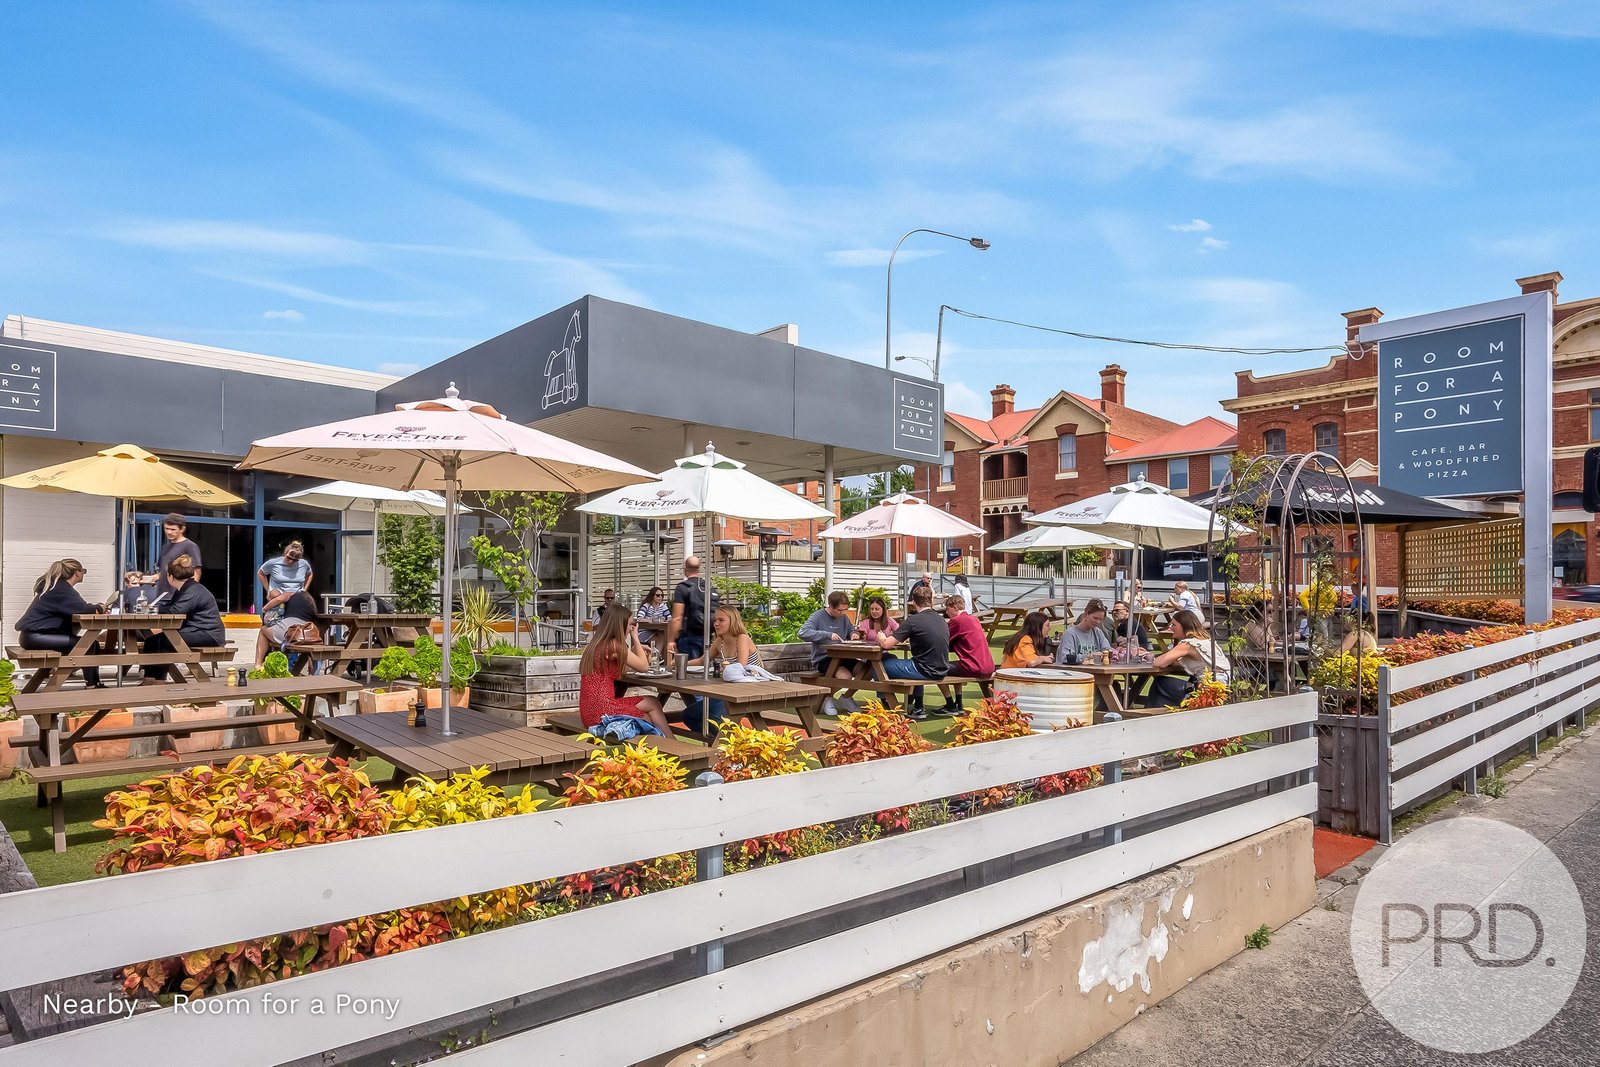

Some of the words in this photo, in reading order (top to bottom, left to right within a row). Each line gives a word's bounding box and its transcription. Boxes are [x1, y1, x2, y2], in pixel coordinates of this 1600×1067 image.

[1394, 341, 1504, 369] ROOM
[11, 363, 41, 374] OM
[1394, 377, 1455, 396] FOR
[1491, 370, 1504, 383] A
[11, 396, 40, 406] NY
[901, 395, 933, 408] ROOM
[901, 409, 919, 419] FOR
[1394, 399, 1504, 423] PONY
[901, 424, 933, 436] PONY
[332, 431, 467, 441] FEVER-TREE
[1458, 443, 1486, 452] BAR
[1413, 454, 1500, 468] WOODFIRED
[1428, 469, 1468, 479] PIZZA
[618, 497, 690, 507] FEVER-TREE
